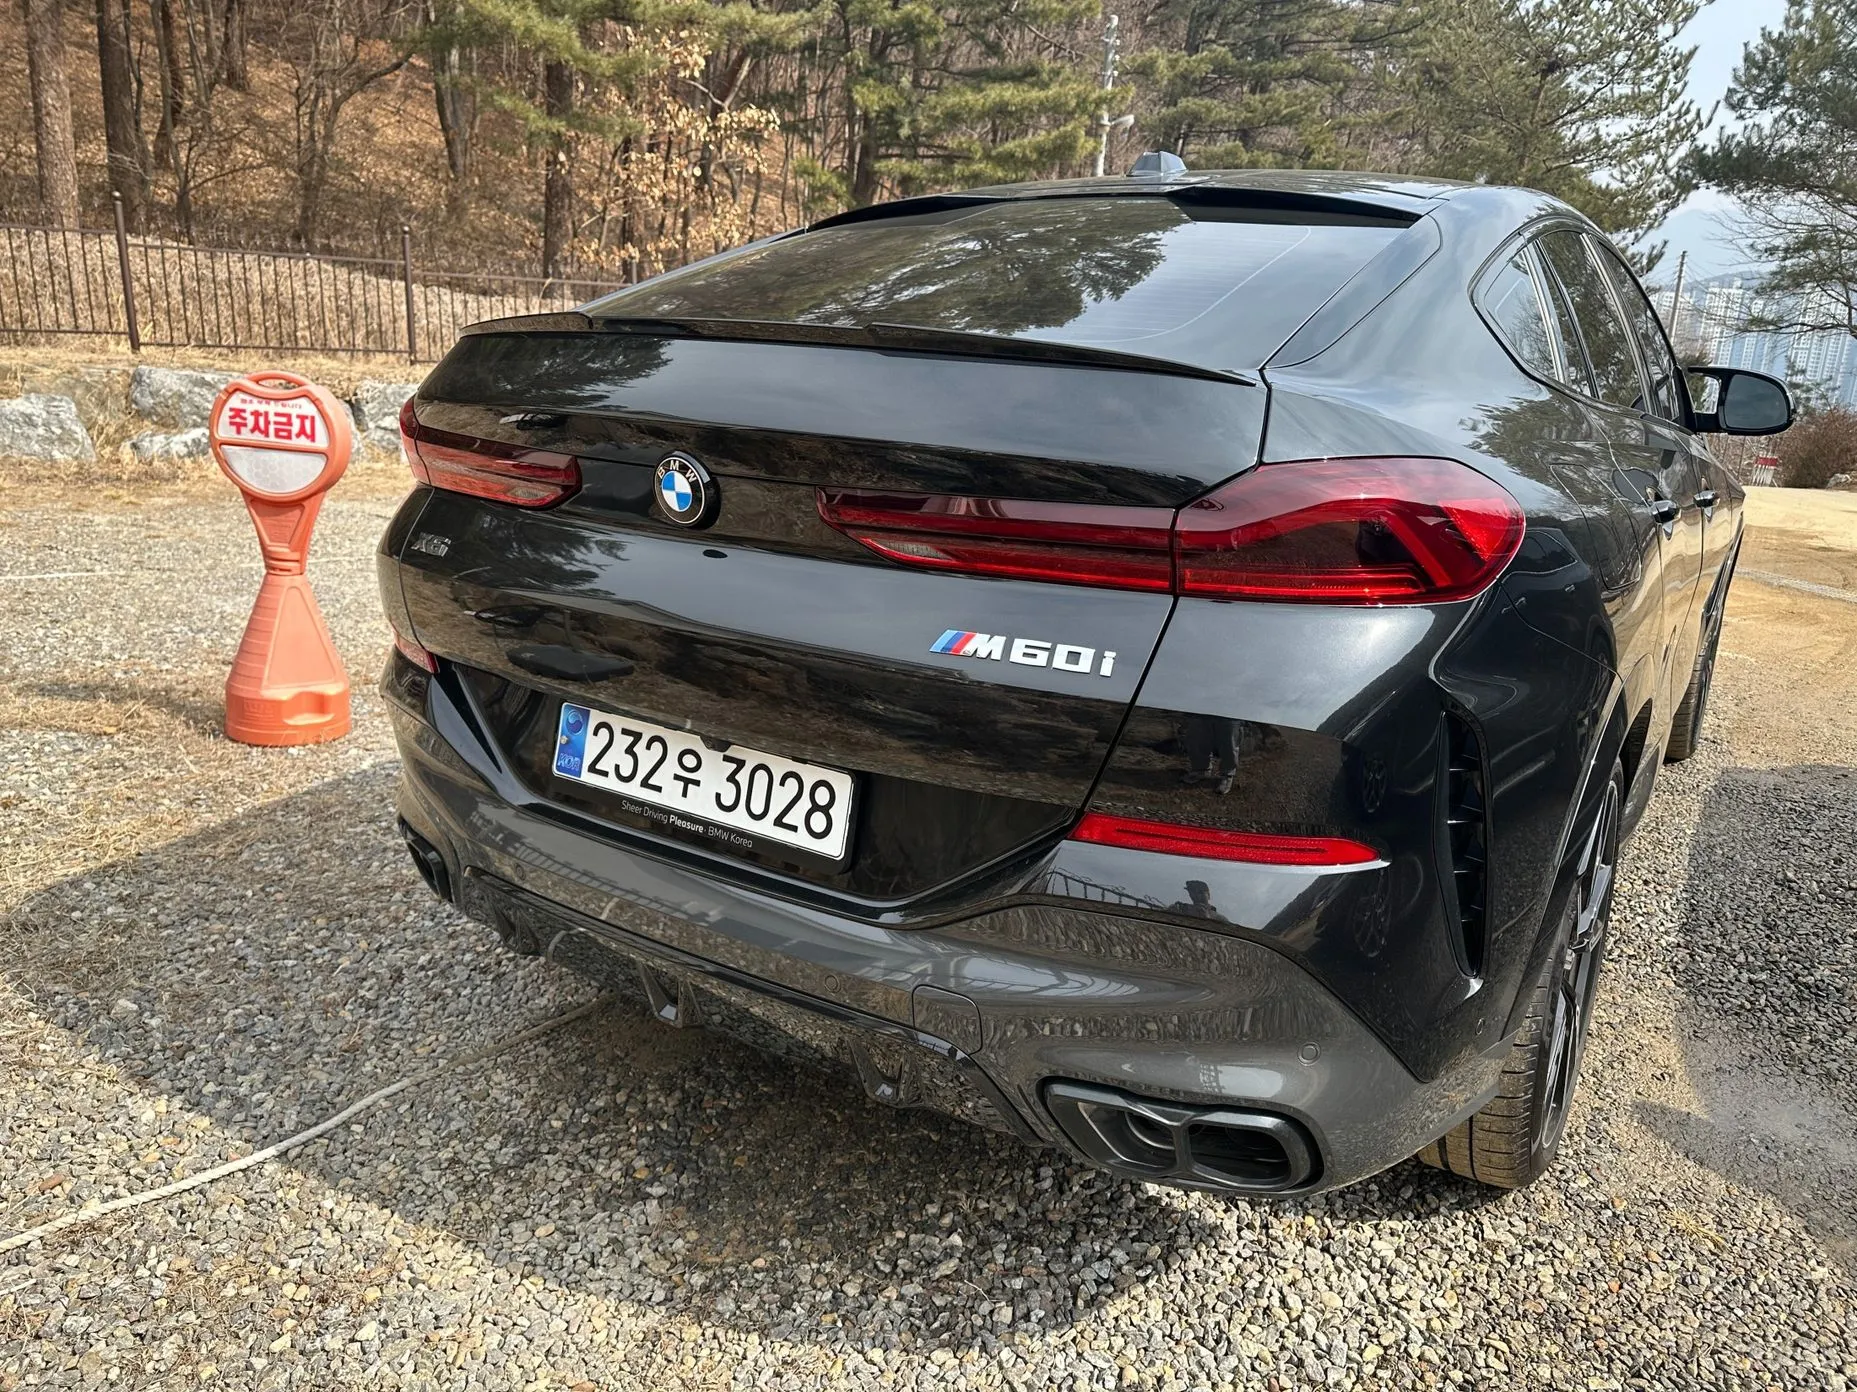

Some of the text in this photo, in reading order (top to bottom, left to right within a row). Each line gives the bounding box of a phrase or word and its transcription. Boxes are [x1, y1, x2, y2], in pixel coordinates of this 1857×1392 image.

[228, 407, 316, 443] 주차금지
[657, 460, 697, 483] BMW
[557, 752, 581, 772] KOR
[587, 721, 837, 840] 232우 3028
[621, 800, 642, 814] Sheer
[643, 806, 668, 824] Driving
[708, 826, 729, 841] BMW
[730, 833, 753, 848] Korea
